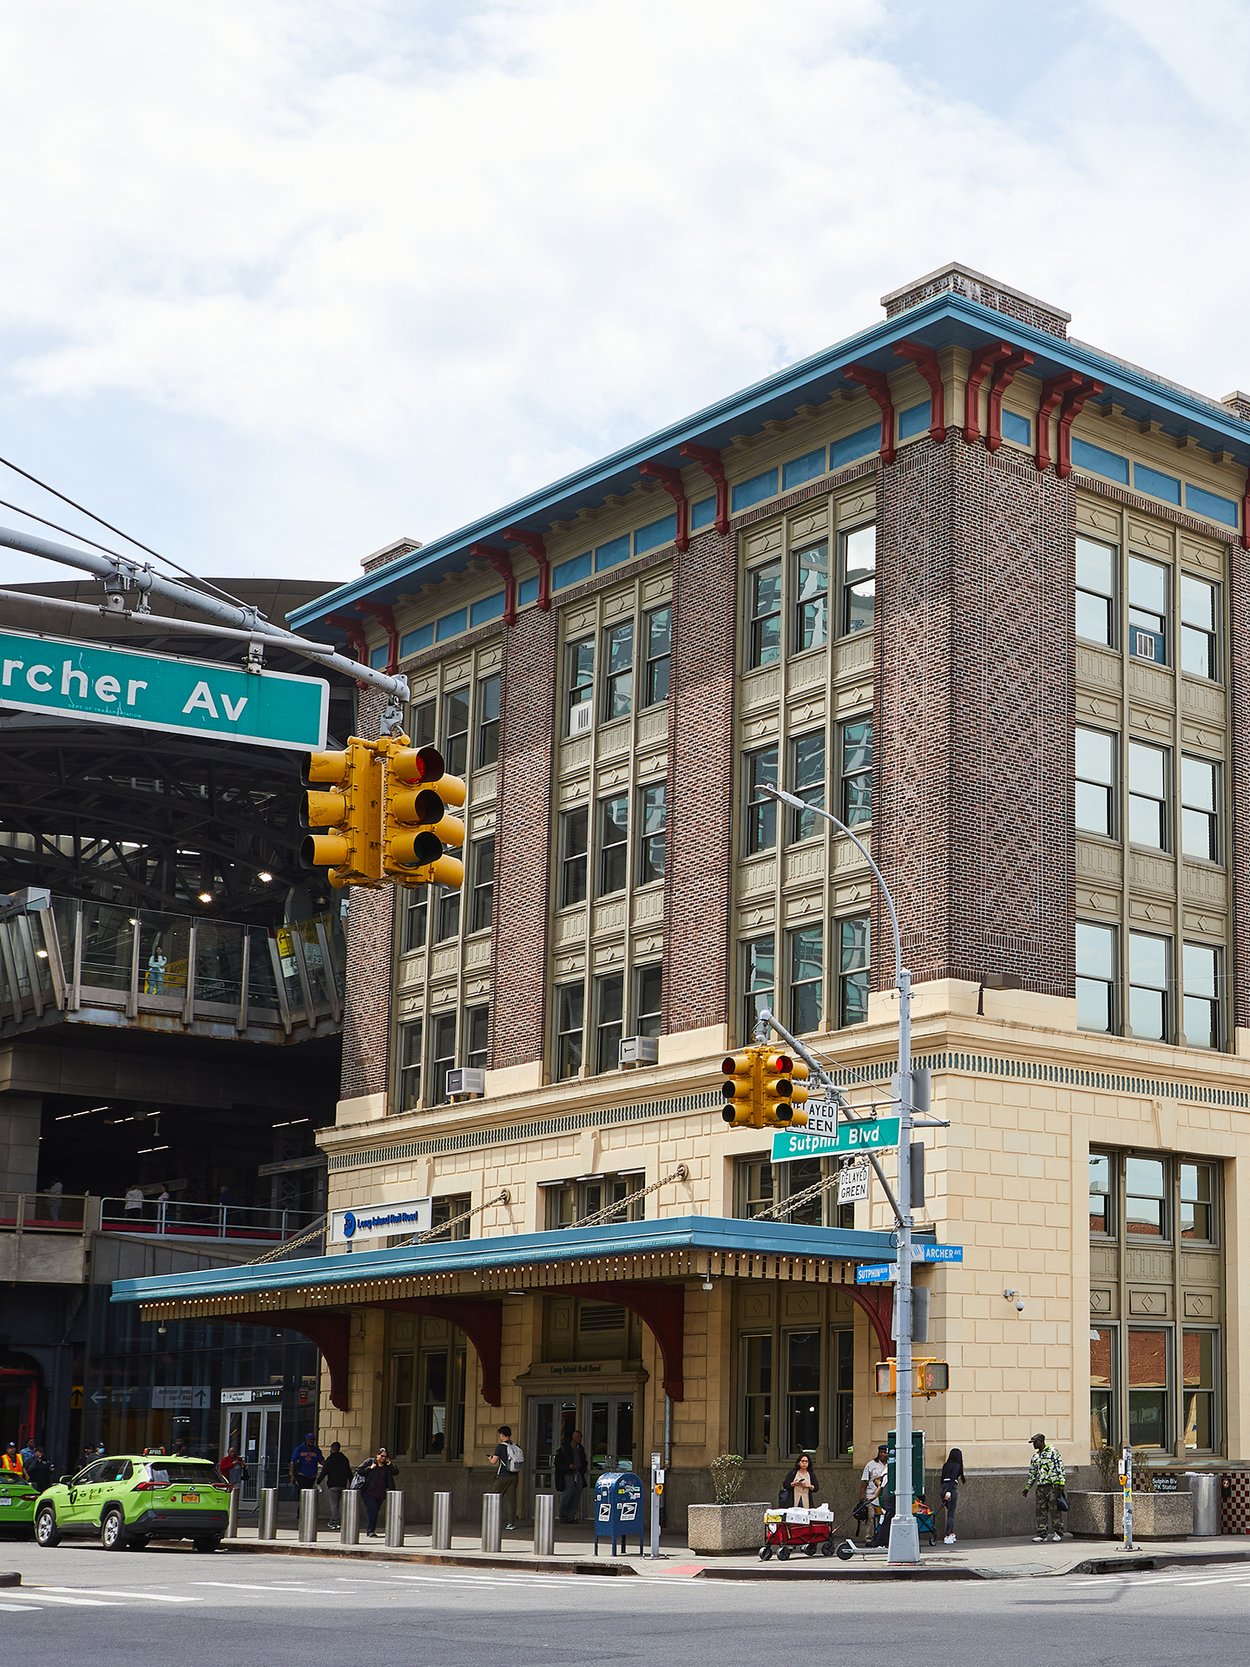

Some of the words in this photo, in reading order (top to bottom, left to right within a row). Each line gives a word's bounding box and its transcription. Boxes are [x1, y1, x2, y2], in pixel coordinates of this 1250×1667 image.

[182, 681, 248, 722] Av
[849, 1125, 879, 1144] Blvd
[841, 1170, 867, 1185] DELAYED
[840, 1185, 866, 1198] GREEN
[357, 1219, 372, 1229] Long
[372, 1215, 390, 1226] Island
[390, 1213, 402, 1223] Rail
[402, 1211, 418, 1222] Road
[926, 1249, 954, 1259] ARCHER
[858, 1269, 880, 1279] SUTPHIN
